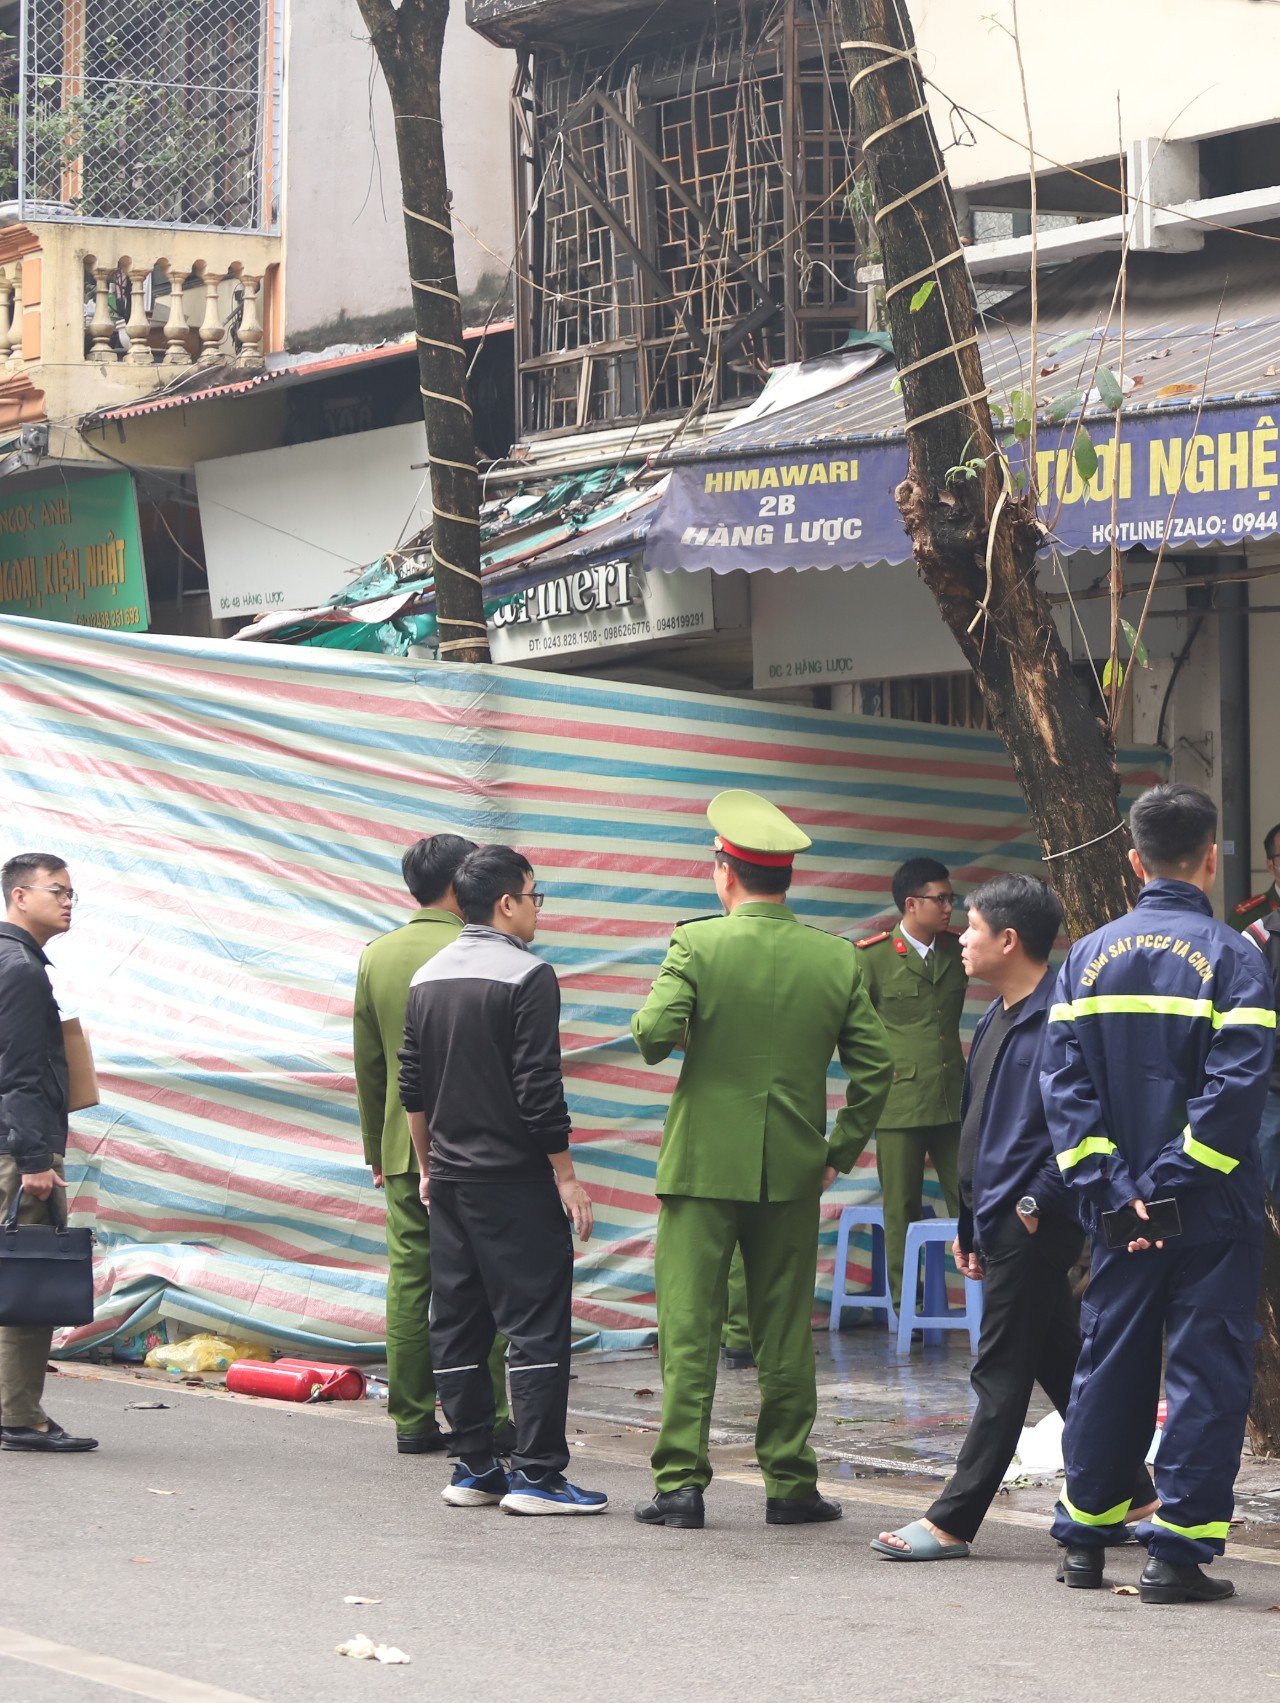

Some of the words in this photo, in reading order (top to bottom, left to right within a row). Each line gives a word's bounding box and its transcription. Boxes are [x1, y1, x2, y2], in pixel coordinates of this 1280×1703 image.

[1149, 415, 1279, 500] NGHỆ
[704, 459, 859, 493] HIMAWARI
[758, 494, 796, 517] 2B
[680, 522, 774, 547] HÀNG
[784, 516, 863, 546] LƯỢC
[1232, 511, 1278, 533] 0944
[86, 529, 125, 596] NHẬT
[243, 592, 263, 606] HÀNG
[528, 639, 541, 652] ĐT:
[543, 630, 597, 650] 0243.828.1508
[603, 620, 651, 640] 0986266776
[656, 612, 704, 631] 0948199291
[786, 663, 793, 677] 2
[795, 659, 822, 675] HÀNG
[826, 657, 853, 674] LƯỢC
[1108, 937, 1132, 958] SÁT
[1136, 934, 1172, 950] PCCC
[1171, 939, 1191, 958] VÀ
